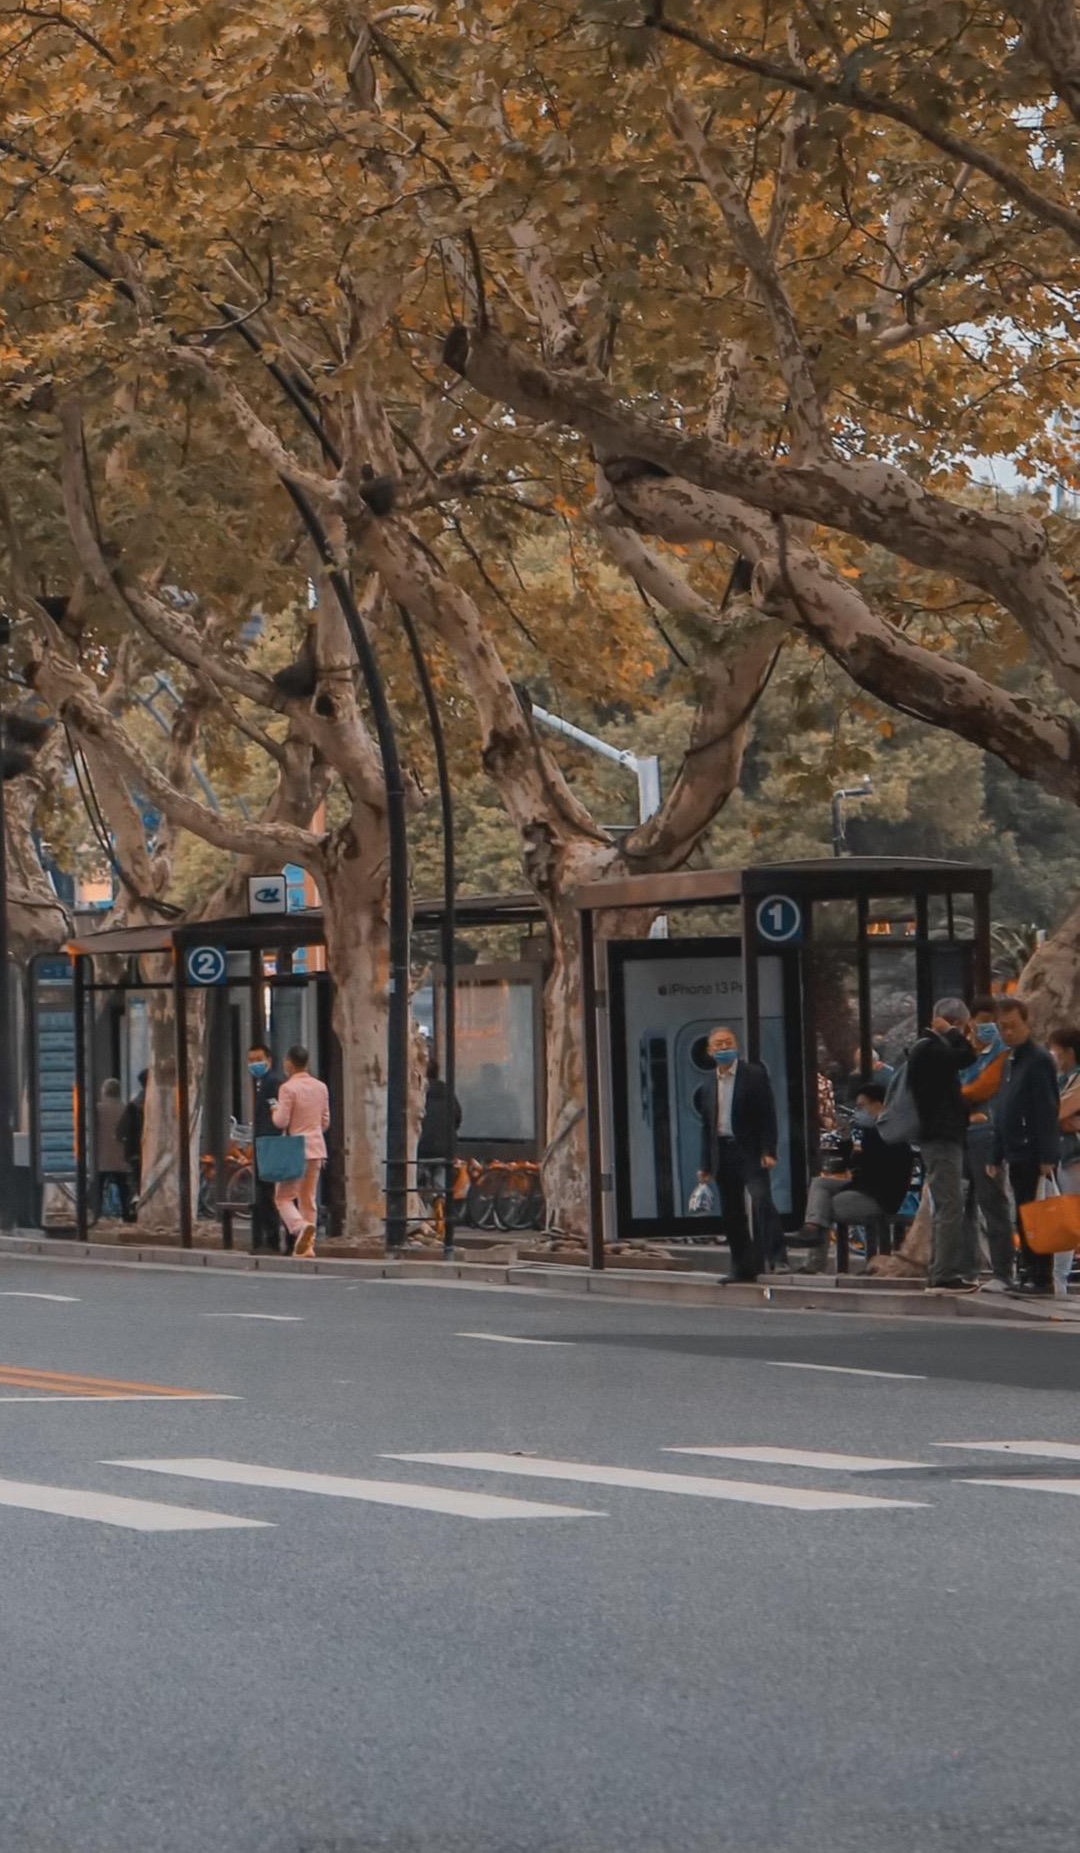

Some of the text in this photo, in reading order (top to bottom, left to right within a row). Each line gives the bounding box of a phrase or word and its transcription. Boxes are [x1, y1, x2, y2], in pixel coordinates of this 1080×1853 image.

[768, 904, 782, 930] 1
[198, 953, 215, 974] 2
[668, 982, 713, 996] iPhone
[715, 981, 729, 994] 13
